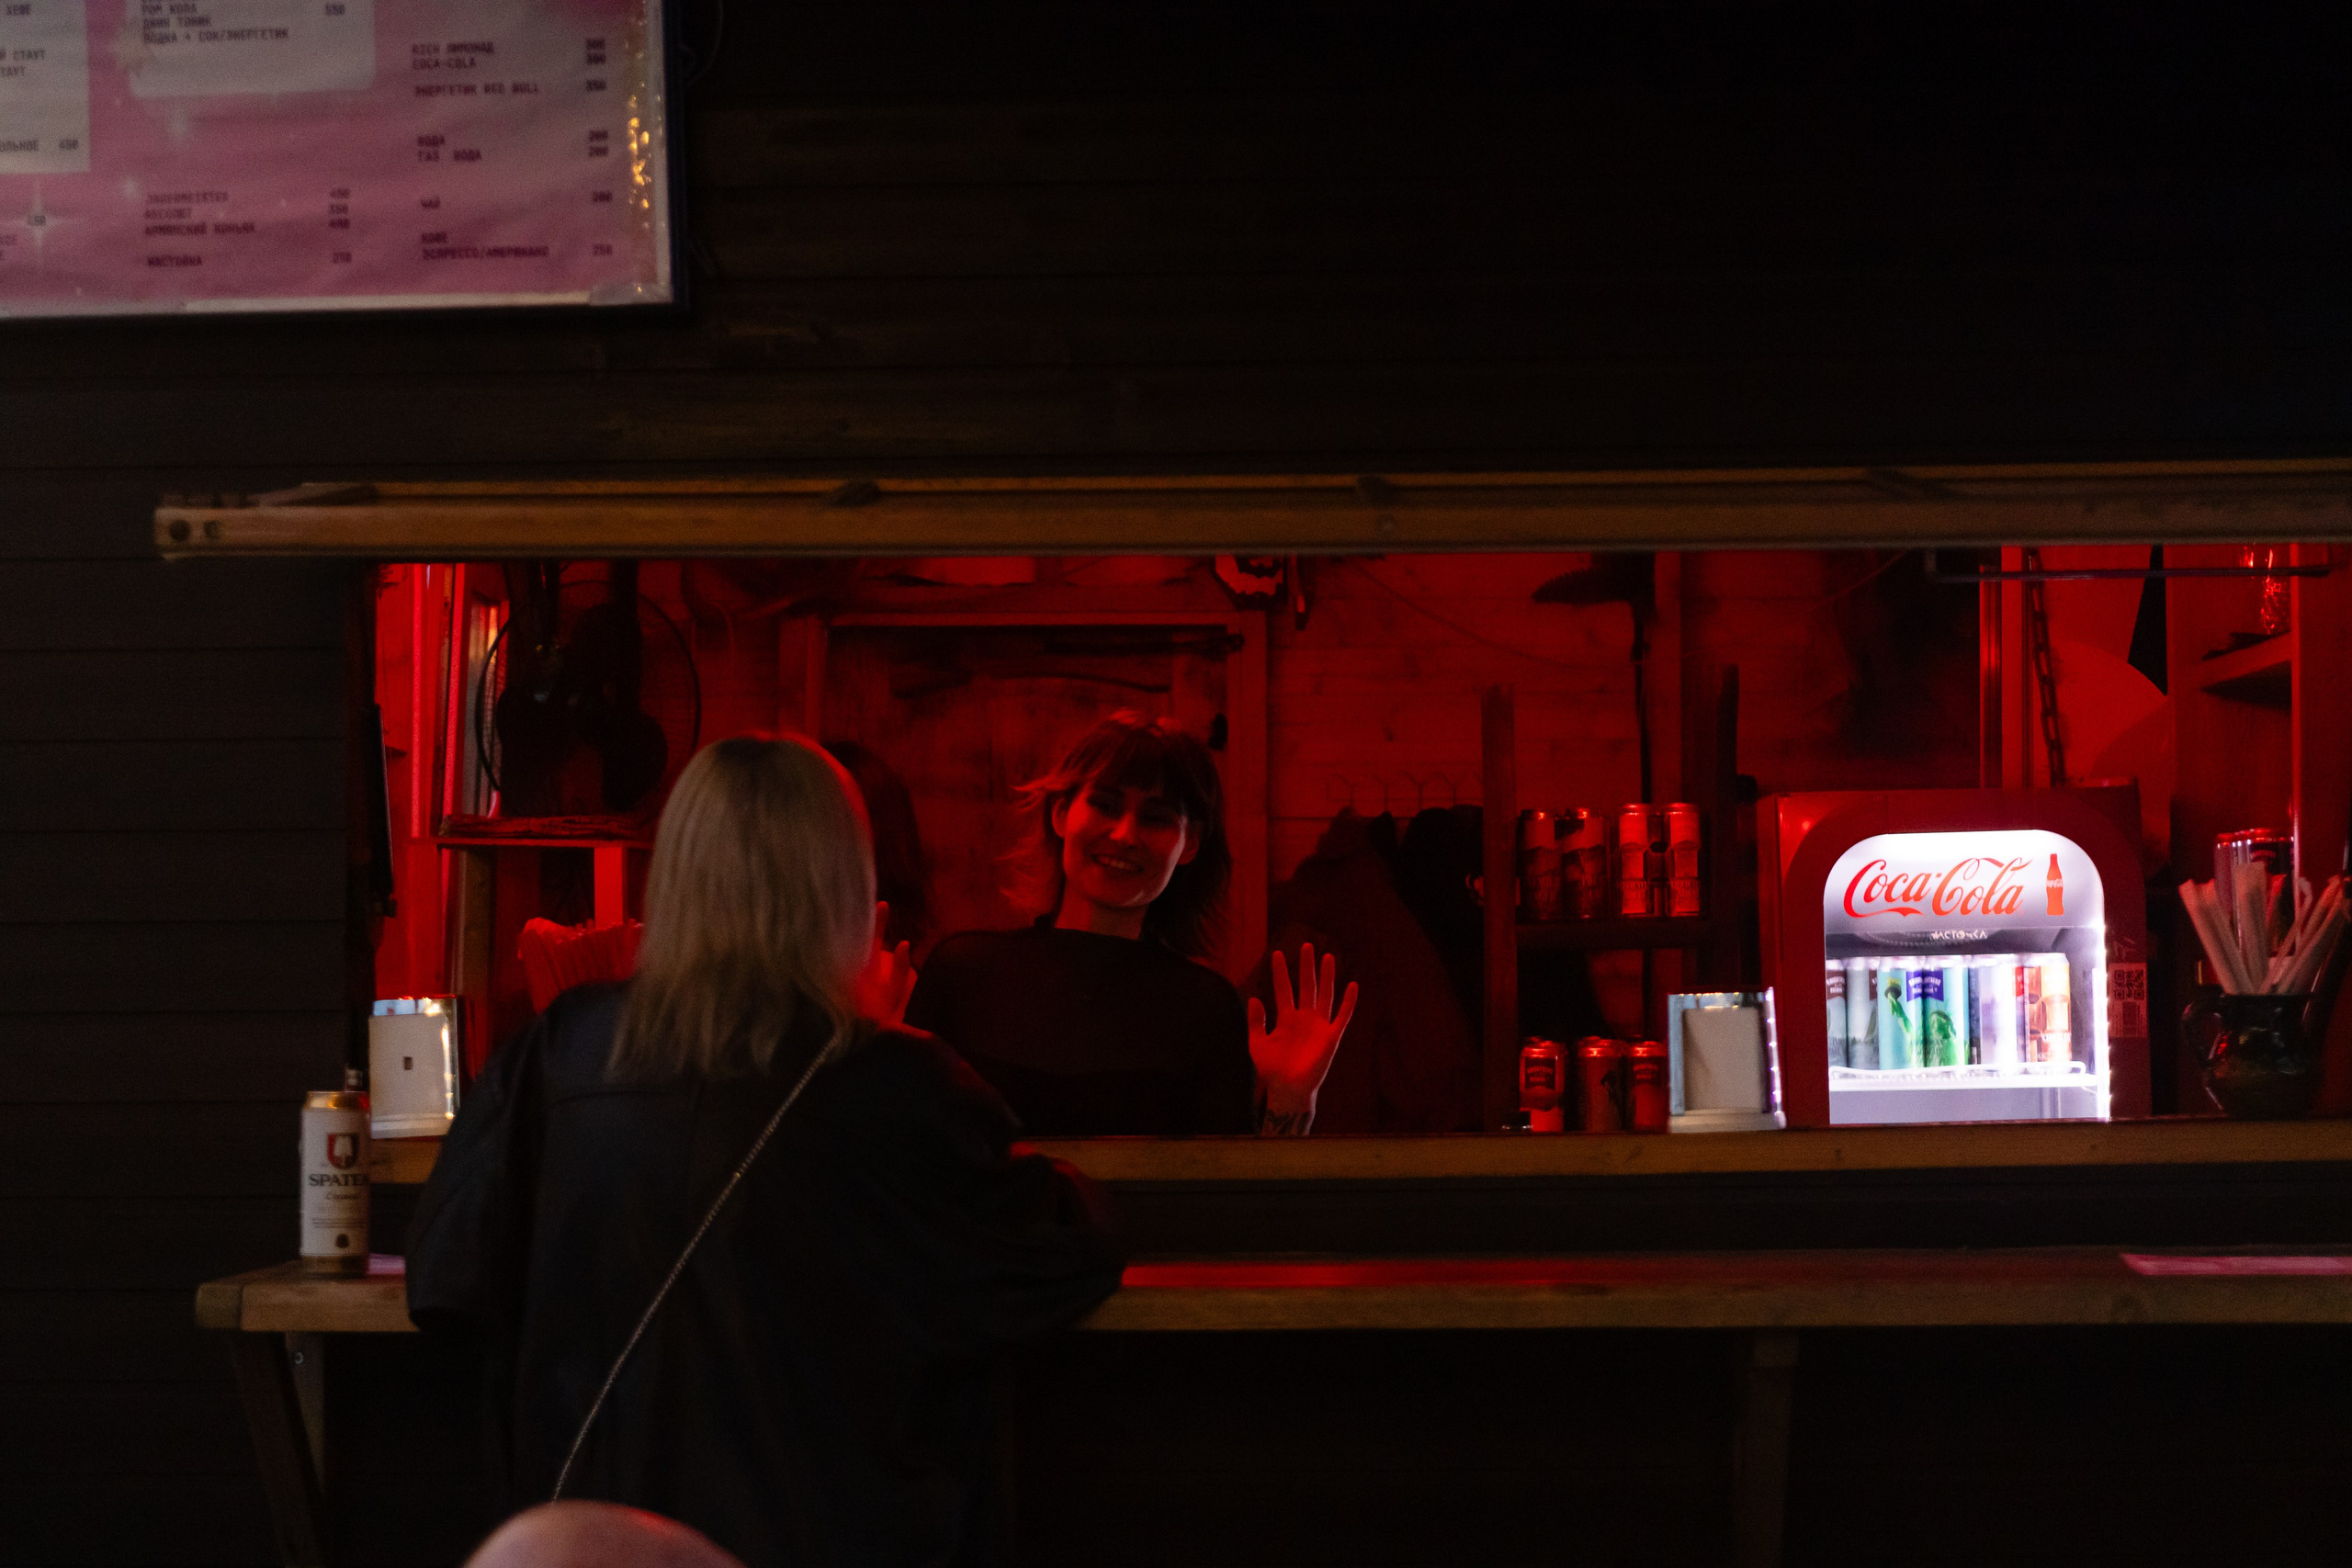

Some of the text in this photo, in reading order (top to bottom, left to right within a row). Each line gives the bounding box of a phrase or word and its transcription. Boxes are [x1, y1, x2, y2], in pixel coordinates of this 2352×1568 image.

[13, 50, 46, 62] СТАУТ
[412, 56, 477, 70] COCA-COLA
[1843, 856, 2034, 919] Coca-Cola
